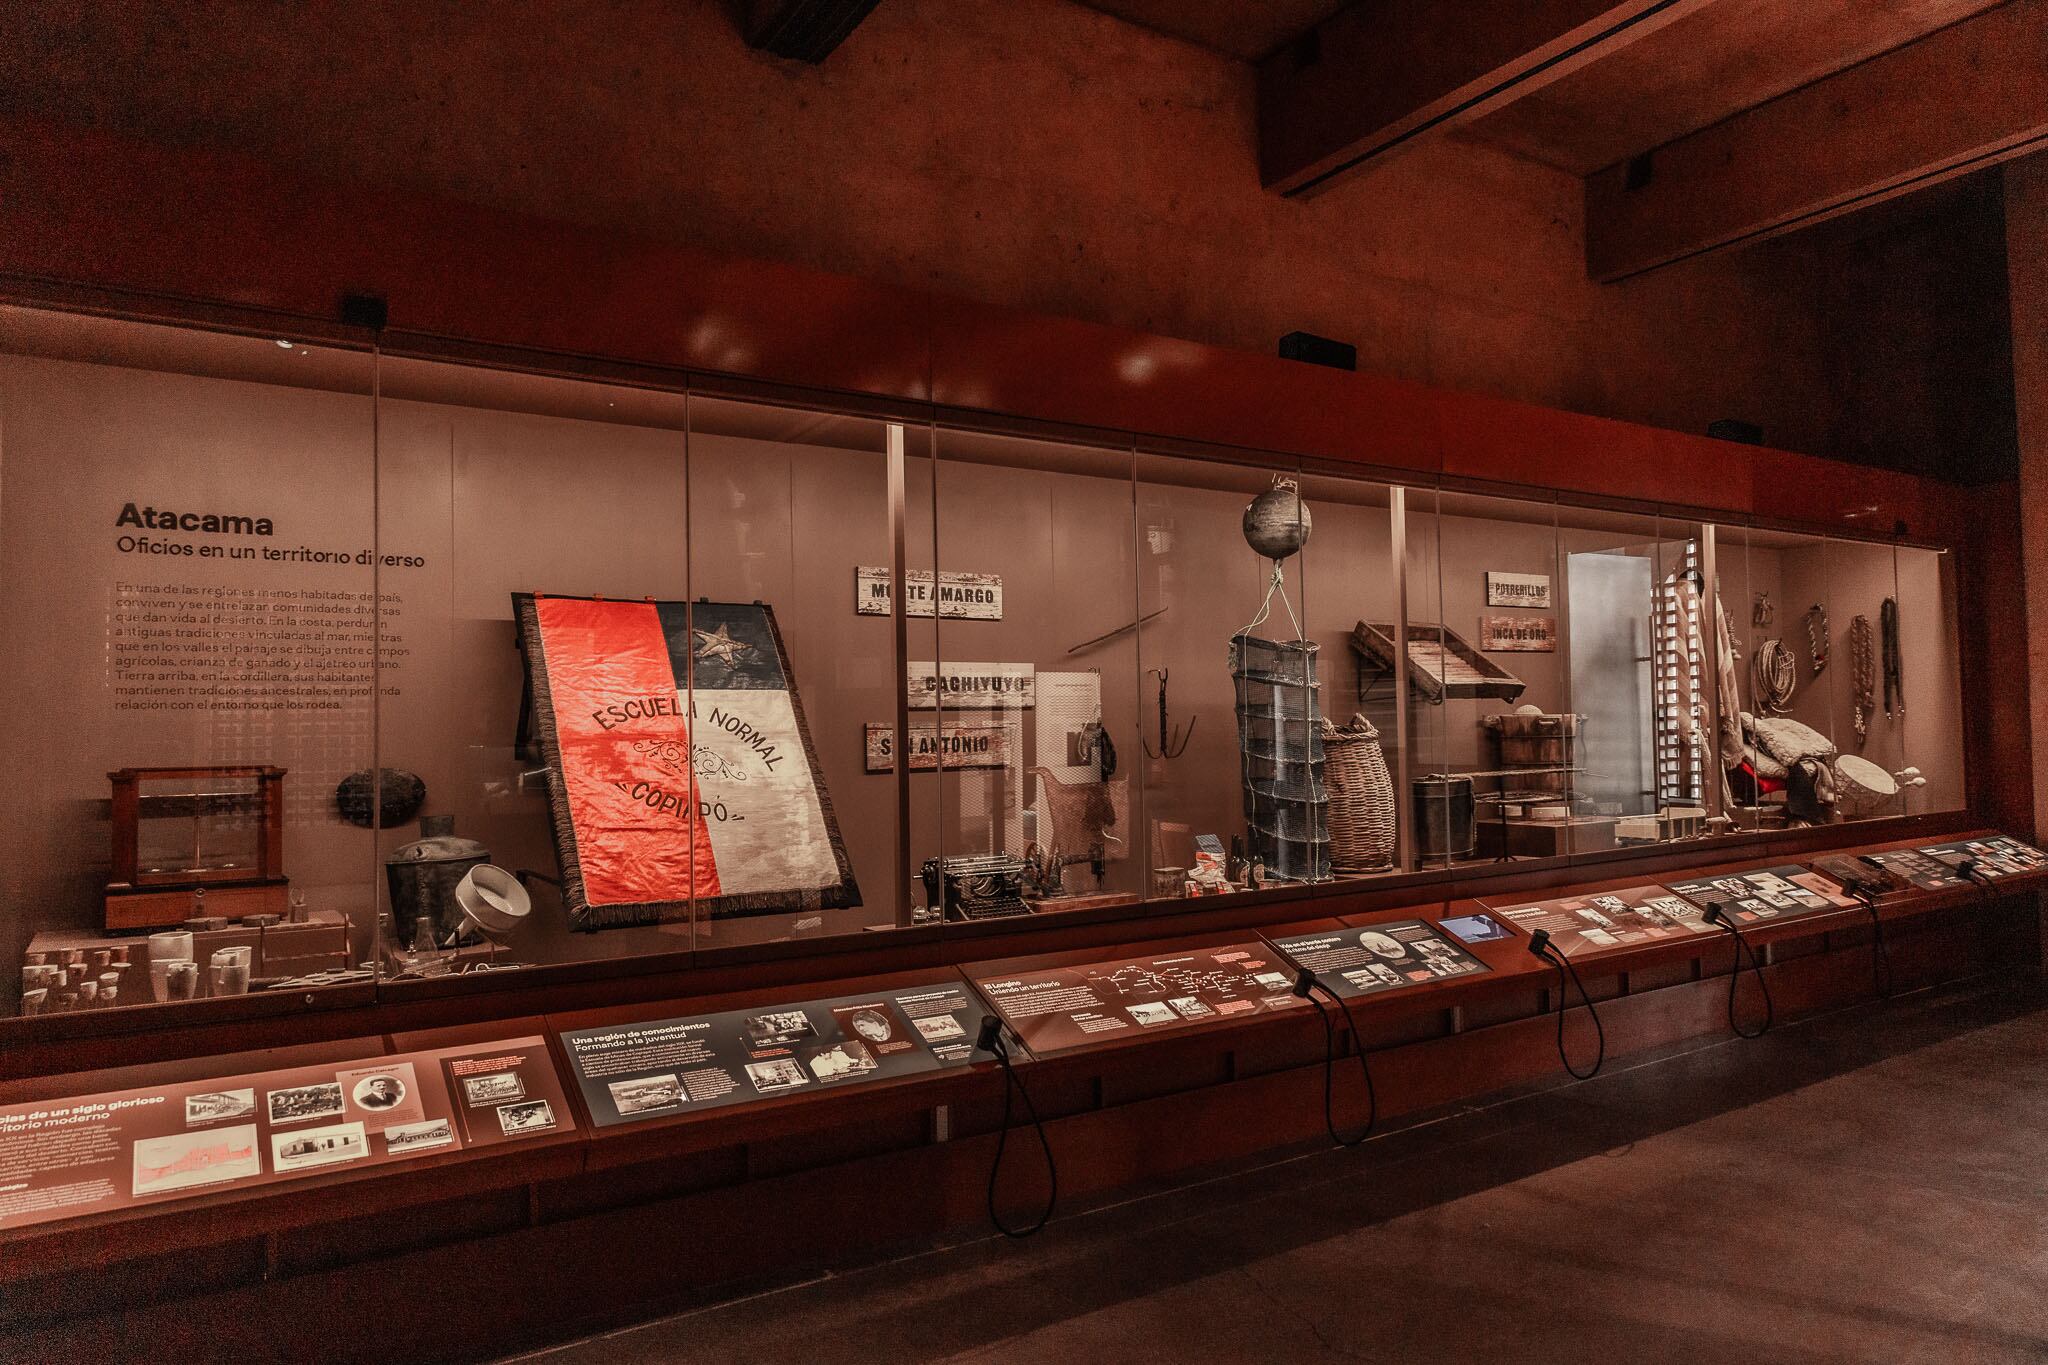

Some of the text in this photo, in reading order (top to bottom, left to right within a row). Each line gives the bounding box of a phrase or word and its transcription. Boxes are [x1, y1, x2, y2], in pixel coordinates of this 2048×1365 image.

[115, 502, 274, 536] Atacama
[116, 535, 194, 556] Oficios
[198, 545, 224, 558] en
[230, 547, 256, 560] un
[262, 545, 351, 565] territorio
[115, 582, 132, 592] En
[136, 585, 160, 593] una
[163, 584, 179, 594] de
[182, 584, 199, 595] las
[202, 585, 254, 600] regiones
[301, 589, 356, 601] habitadas
[872, 584, 926, 600] MTE
[115, 596, 175, 608] conviven
[179, 601, 186, 611] y
[189, 601, 203, 609] se
[273, 602, 351, 614] comunidades
[115, 613, 141, 624] que
[143, 612, 167, 622] dan
[170, 613, 196, 623] vida
[200, 613, 210, 623] al
[269, 615, 283, 625] En
[287, 616, 296, 626] la
[337, 617, 387, 631] perdurn
[176, 627, 245, 638] tradiciones
[248, 629, 310, 640] vinculadas
[315, 630, 324, 640] al
[353, 631, 402, 642] mietras
[1493, 628, 1546, 640] INCA DE ORO
[115, 643, 139, 653] que
[143, 643, 159, 651] en
[162, 641, 180, 651] los
[184, 642, 219, 652] valles
[222, 642, 232, 652] el
[235, 643, 277, 656] paisaje
[296, 644, 331, 657] dibuja
[335, 644, 363, 654] entre
[367, 647, 410, 658] cmpos
[180, 656, 225, 666] crianza
[246, 657, 291, 670] ganado
[293, 660, 300, 670] y
[304, 658, 313, 667] el
[316, 658, 356, 671] ajetreo
[115, 670, 155, 680] Tierra
[201, 673, 217, 681] en
[220, 671, 230, 681] la
[233, 671, 292, 684] cordillera,
[925, 676, 1024, 692] CACHIYUYO
[115, 685, 185, 694] mantienen
[189, 685, 258, 695] tradiciones
[260, 685, 331, 698] ancestrales,
[350, 686, 400, 698] profnda
[115, 700, 168, 709] relación
[197, 700, 208, 709] el
[210, 699, 259, 709] entorno
[262, 702, 283, 712] que
[286, 699, 303, 709] los
[306, 699, 342, 709] rodea.
[592, 697, 784, 772] ESCUELA NORMAL
[920, 736, 988, 755] ANTONIO
[1030, 980, 1061, 990] territorio
[572, 1022, 710, 1045] Una región de conocimientos
[575, 1039, 626, 1052] Formando
[644, 1031, 687, 1045] juventud
[29, 1110, 48, 1120] de
[51, 1108, 70, 1117] un
[72, 1103, 106, 1116] siglo
[109, 1096, 165, 1111] glorioso
[44, 1111, 111, 1127] moderno
